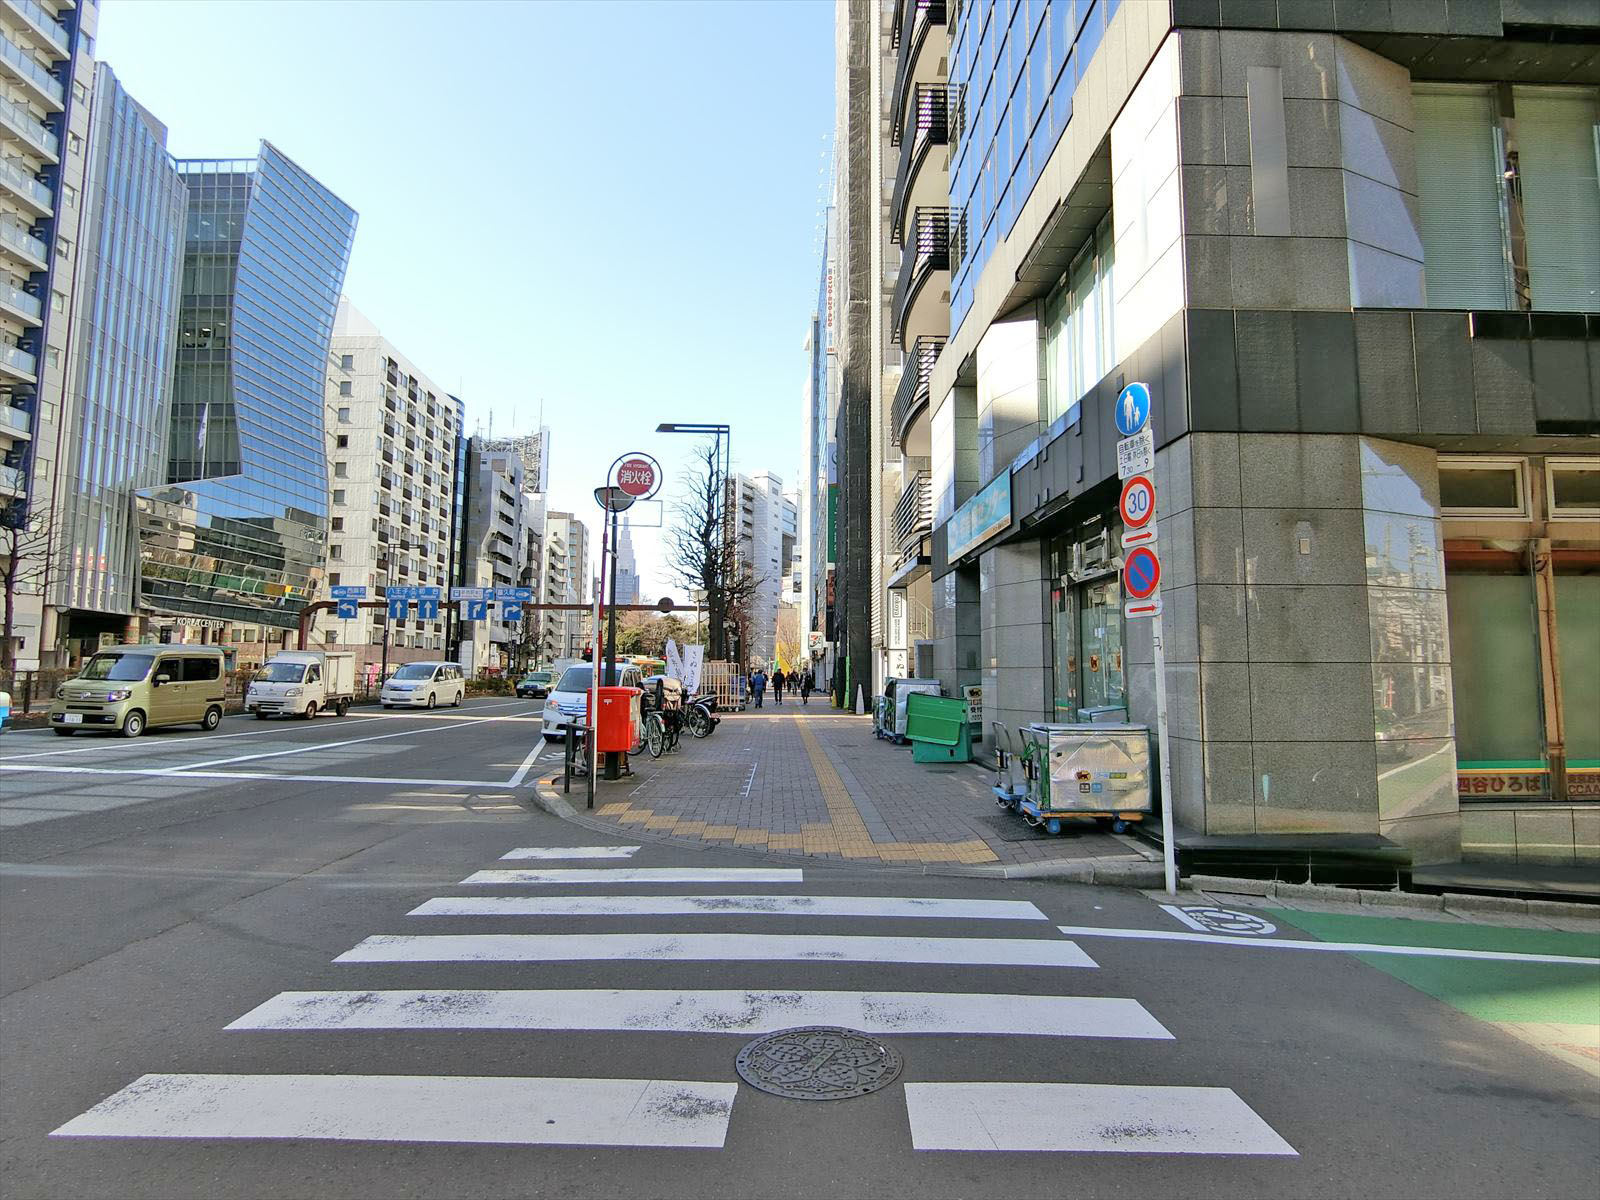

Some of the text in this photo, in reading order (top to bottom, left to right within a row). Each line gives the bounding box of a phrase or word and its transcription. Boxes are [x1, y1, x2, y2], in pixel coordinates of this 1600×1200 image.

[1119, 435, 1150, 453] 自転車を除く
[1144, 457, 1149, 468] 9
[620, 470, 652, 485] 消火栓
[1128, 489, 1147, 514] 30
[200, 620, 224, 629] CENTER
[1457, 776, 1541, 793] 四谷ひろば
